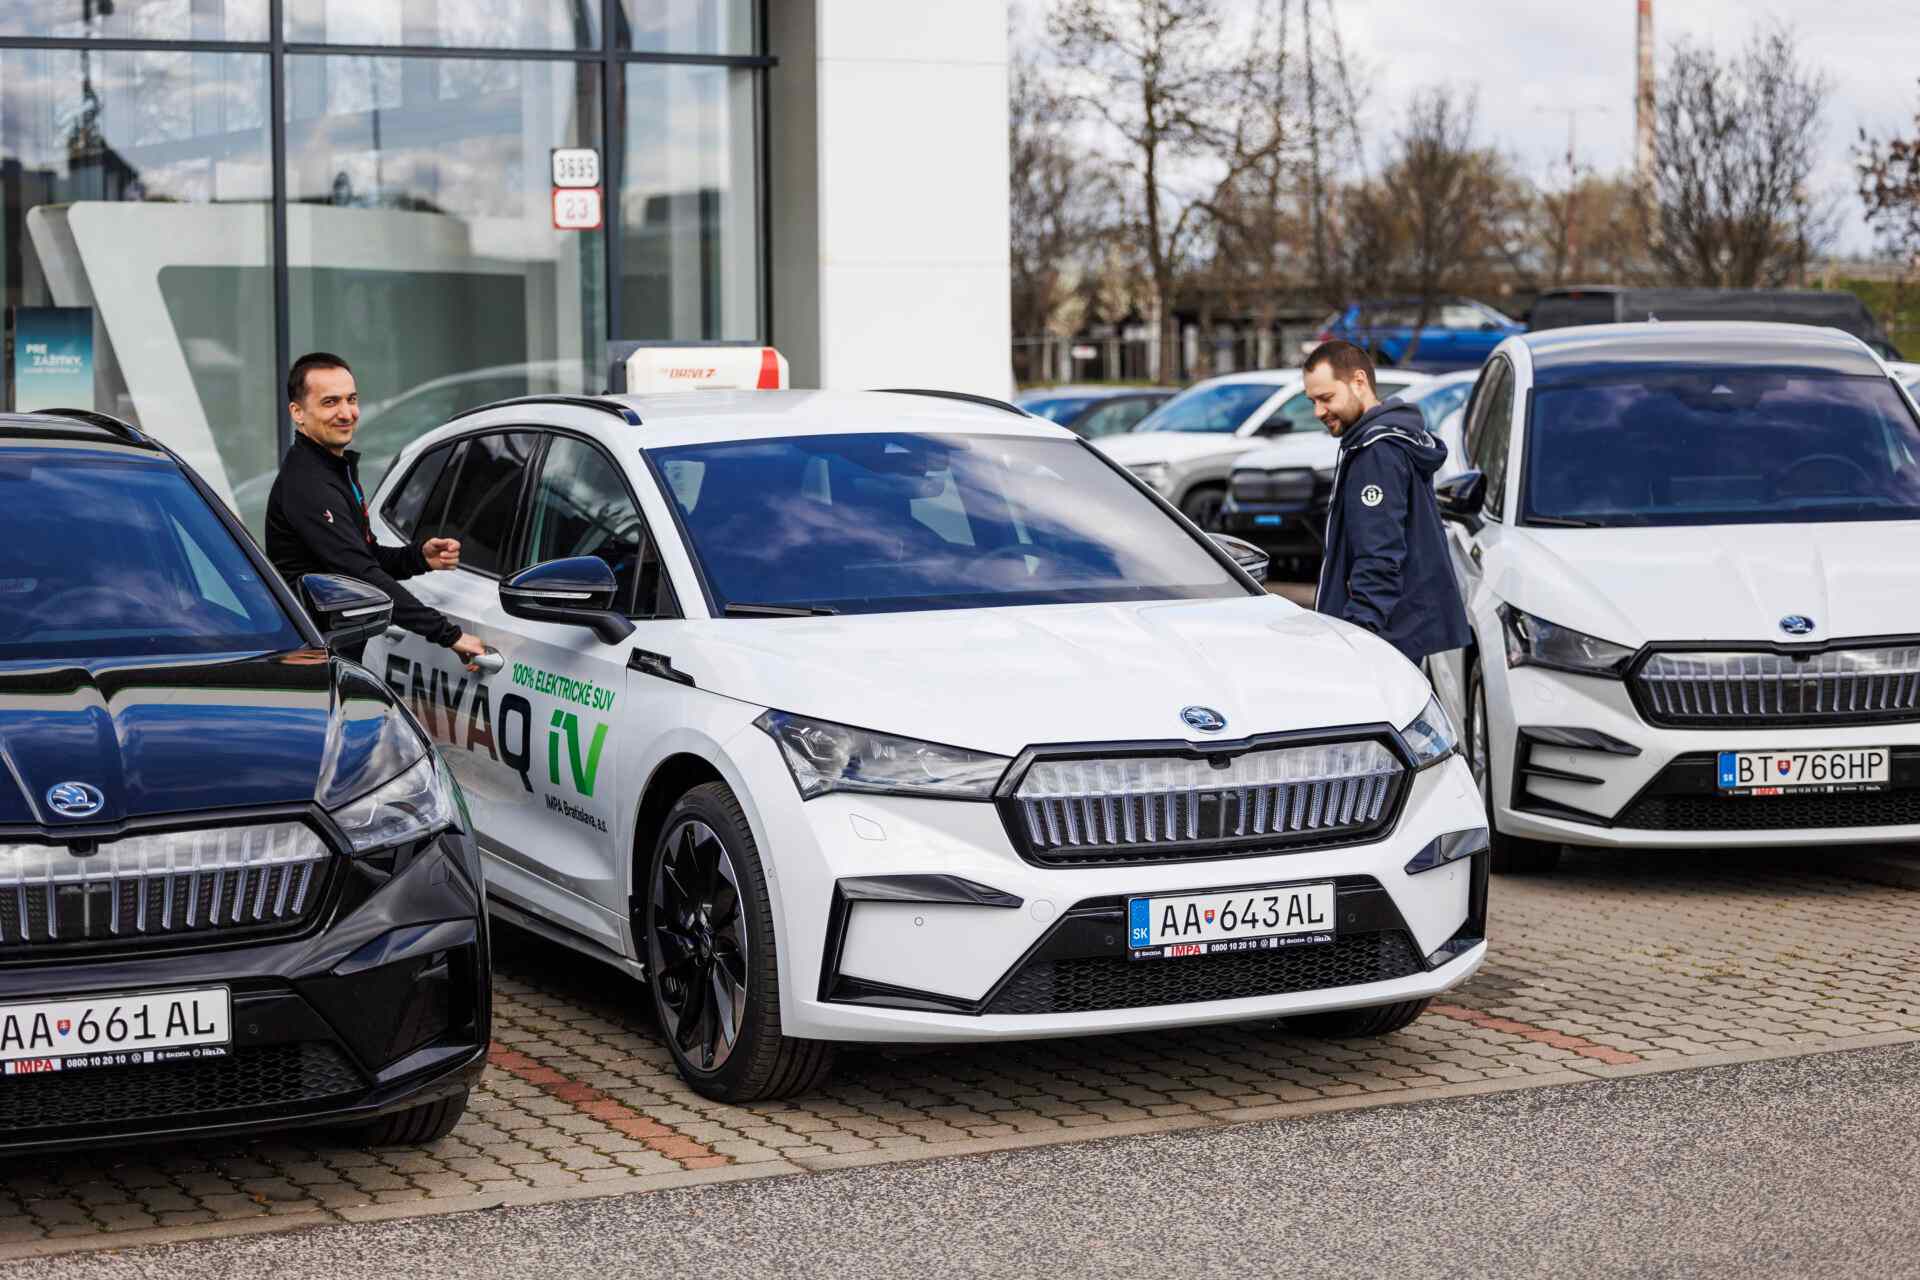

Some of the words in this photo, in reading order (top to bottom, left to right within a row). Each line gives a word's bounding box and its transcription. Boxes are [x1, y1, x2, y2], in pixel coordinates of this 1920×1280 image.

[565, 197, 589, 220] 23
[512, 662, 534, 689] 100%
[535, 670, 593, 706] ELEKTRICKÉ
[592, 687, 616, 712] SUV
[544, 792, 565, 815] IMPA
[1133, 927, 1148, 940] SK
[1171, 944, 1201, 957] IMPA
[1211, 942, 1228, 953] 0800
[1229, 942, 1238, 951] 10
[1238, 942, 1247, 951] 20
[1248, 940, 1257, 949] 10
[14, 1059, 55, 1074] IMPA
[66, 1057, 88, 1068] 0800
[90, 1057, 101, 1066] 10
[102, 1055, 114, 1065] 20
[115, 1054, 126, 1065] 10
